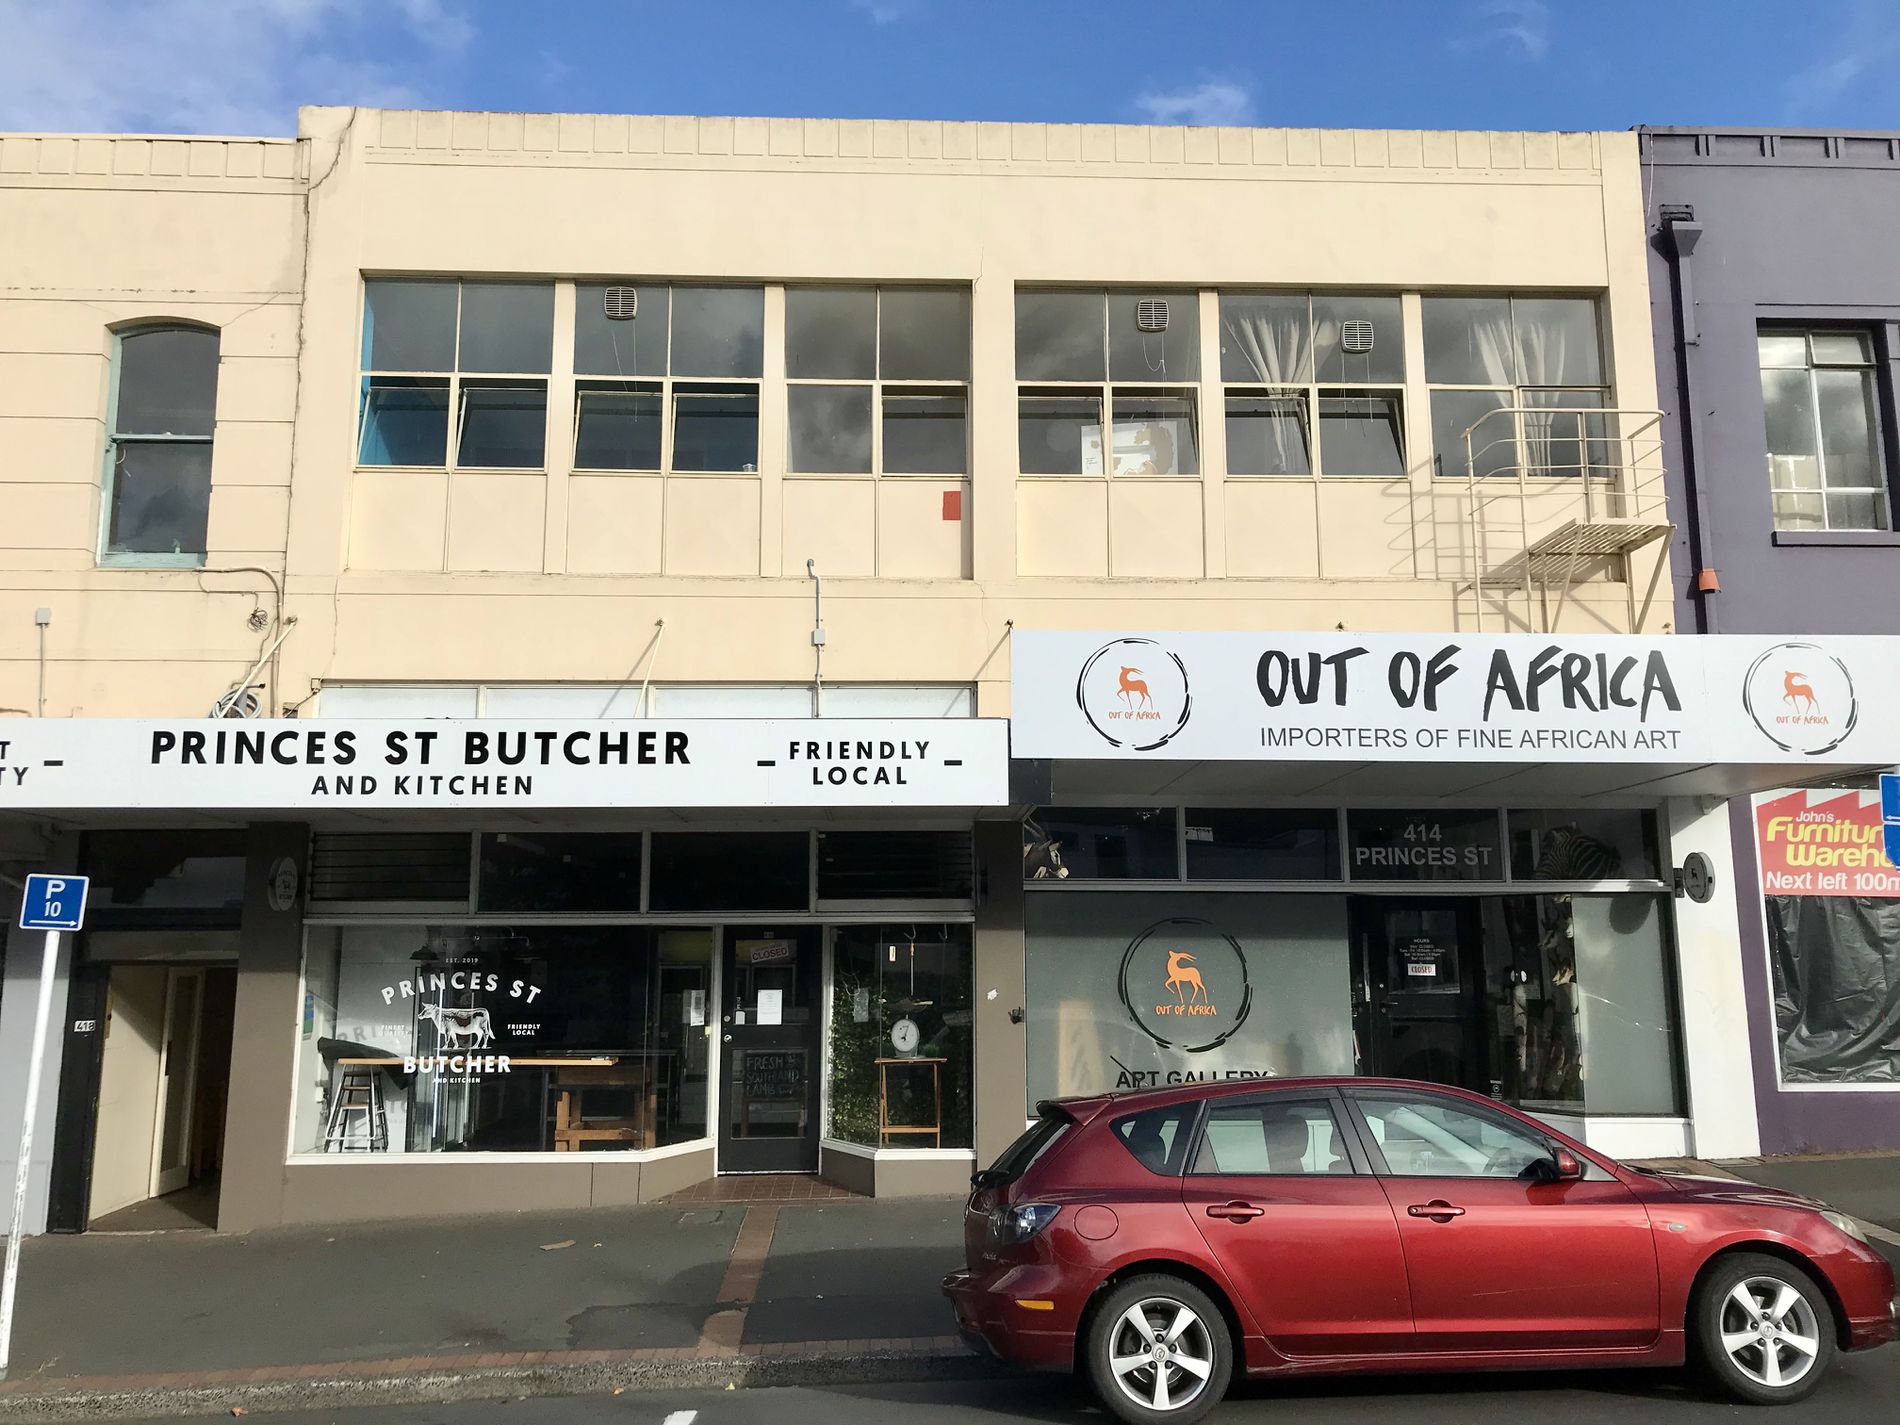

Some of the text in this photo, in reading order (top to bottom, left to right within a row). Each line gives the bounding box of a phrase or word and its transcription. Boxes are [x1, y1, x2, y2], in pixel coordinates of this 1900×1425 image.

[1256, 644, 1682, 722] OUT OF AFRICA
[1108, 711, 1161, 720] OUT OF AFRICA
[1775, 715, 1828, 725] OUT OF AFRICA
[151, 730, 691, 765] PRINCES ST BUTCHER
[1261, 727, 1681, 749] IMPORTERS OF FINE AFRICAN ART
[789, 741, 930, 760] FRIENDLY
[311, 775, 532, 795] AND KITCHEN
[812, 766, 907, 786] LOCAL
[1796, 811, 1835, 822] John's
[1403, 823, 1443, 842] 414
[1766, 816, 1884, 844] Furnitur
[1355, 846, 1492, 866] PRINCES ST
[45, 879, 66, 899] P
[1766, 871, 1812, 890] Next
[1817, 872, 1848, 890] left
[44, 901, 62, 918] 10
[752, 947, 788, 961] CLOSED
[1411, 965, 1433, 974] CLOSED
[381, 971, 542, 1006] PRINCES ST
[1155, 1004, 1217, 1017] OUT OF AFRICA
[403, 1055, 512, 1074] BUTCHER
[746, 1056, 784, 1071] FRESH
[1116, 1071, 1160, 1089] ART
